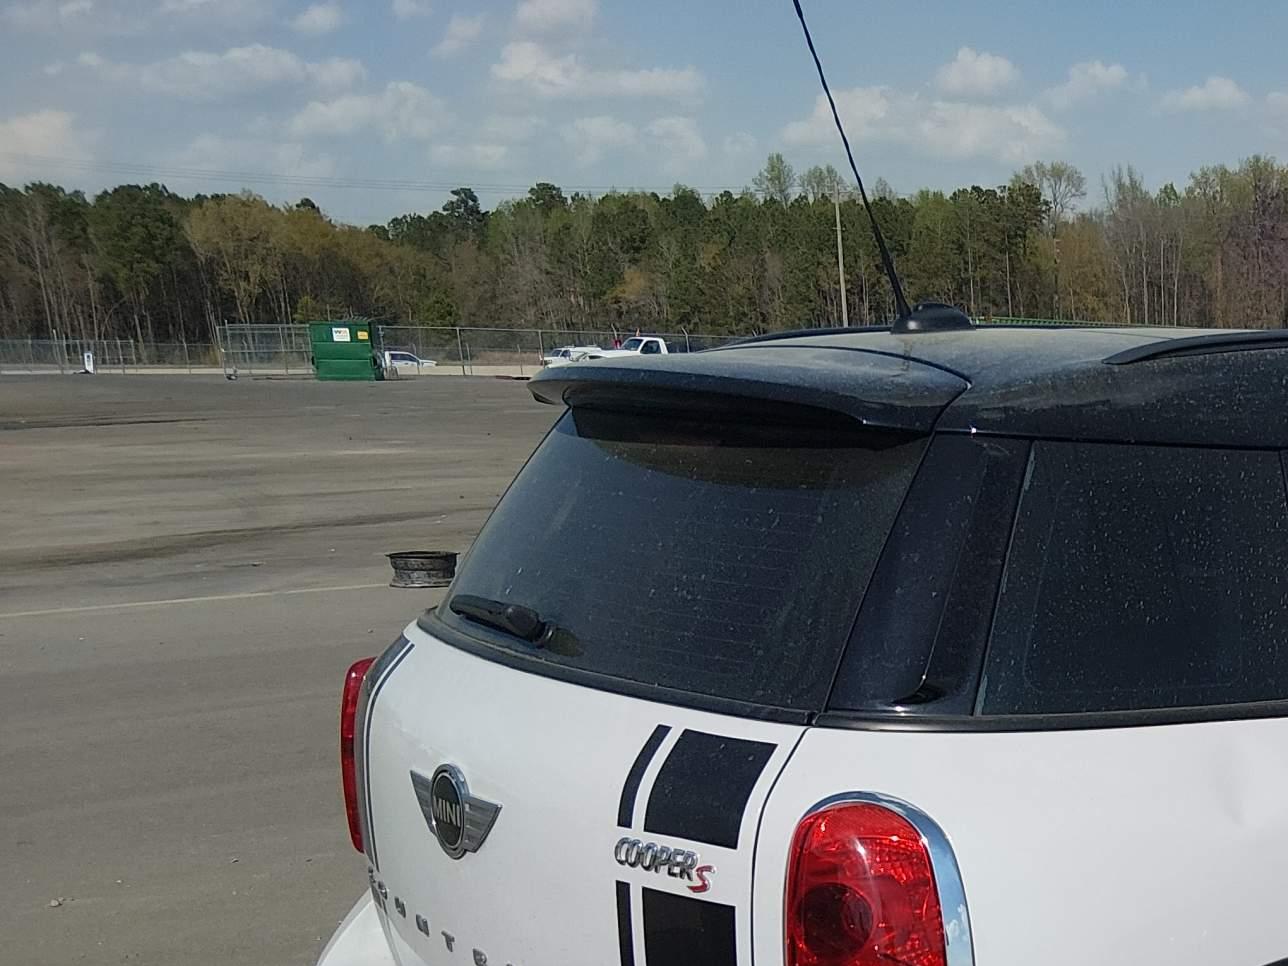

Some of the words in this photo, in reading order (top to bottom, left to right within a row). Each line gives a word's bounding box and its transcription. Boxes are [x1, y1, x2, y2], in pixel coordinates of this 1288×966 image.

[432, 795, 461, 827] MINI
[615, 837, 698, 880] COOPER
[687, 865, 715, 893] S
